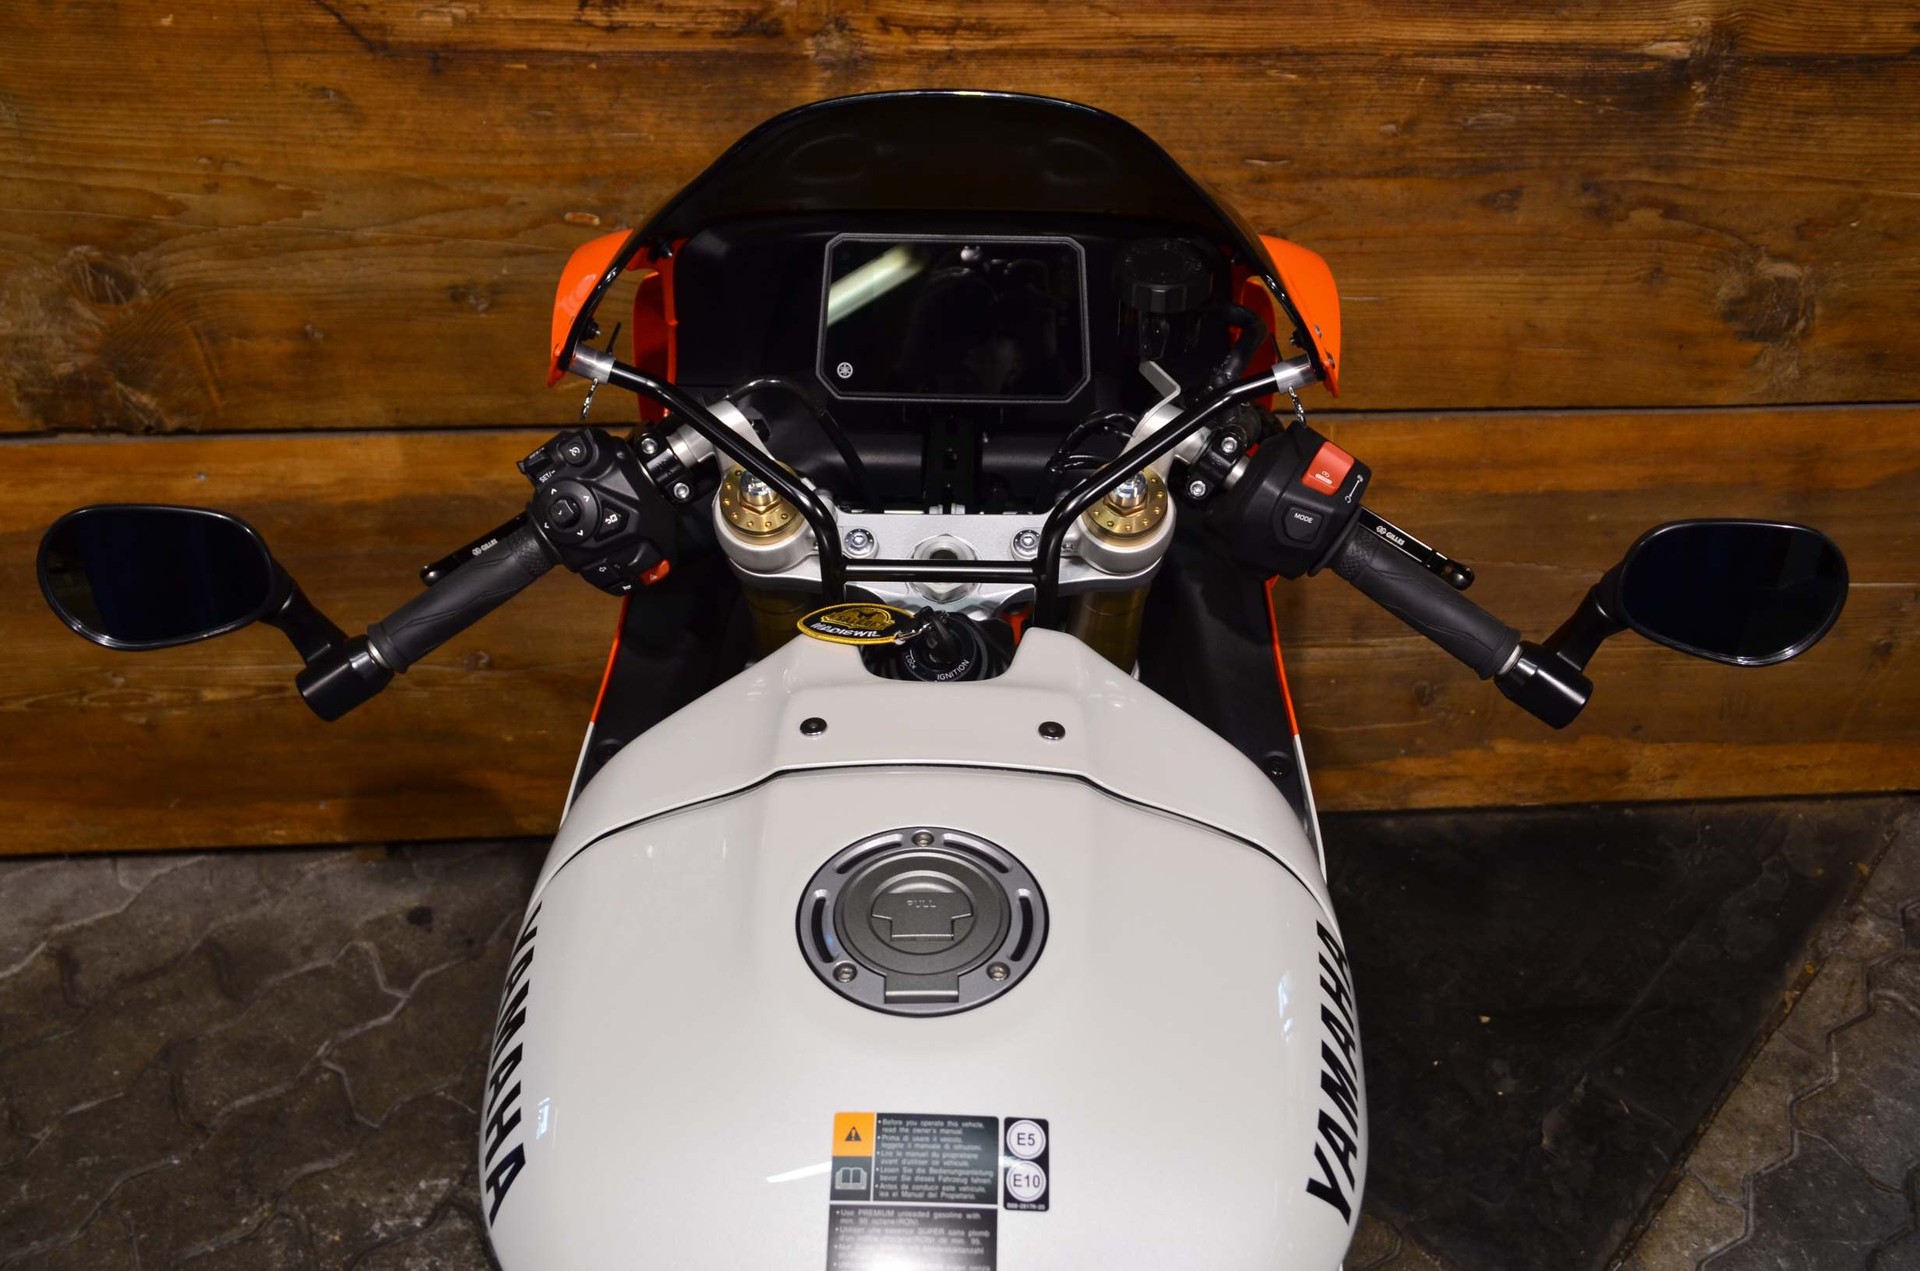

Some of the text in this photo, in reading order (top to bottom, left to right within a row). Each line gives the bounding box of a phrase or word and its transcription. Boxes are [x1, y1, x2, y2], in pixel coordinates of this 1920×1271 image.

[1294, 512, 1313, 524] MODE
[480, 538, 499, 551] GILLES
[1386, 531, 1405, 547] GILLES
[937, 659, 970, 681] IGNITION
[1306, 920, 1357, 1225] YAMAHA
[882, 1118, 903, 1126] Before
[1017, 1132, 1035, 1146] E5
[1013, 1173, 1041, 1188] E10
